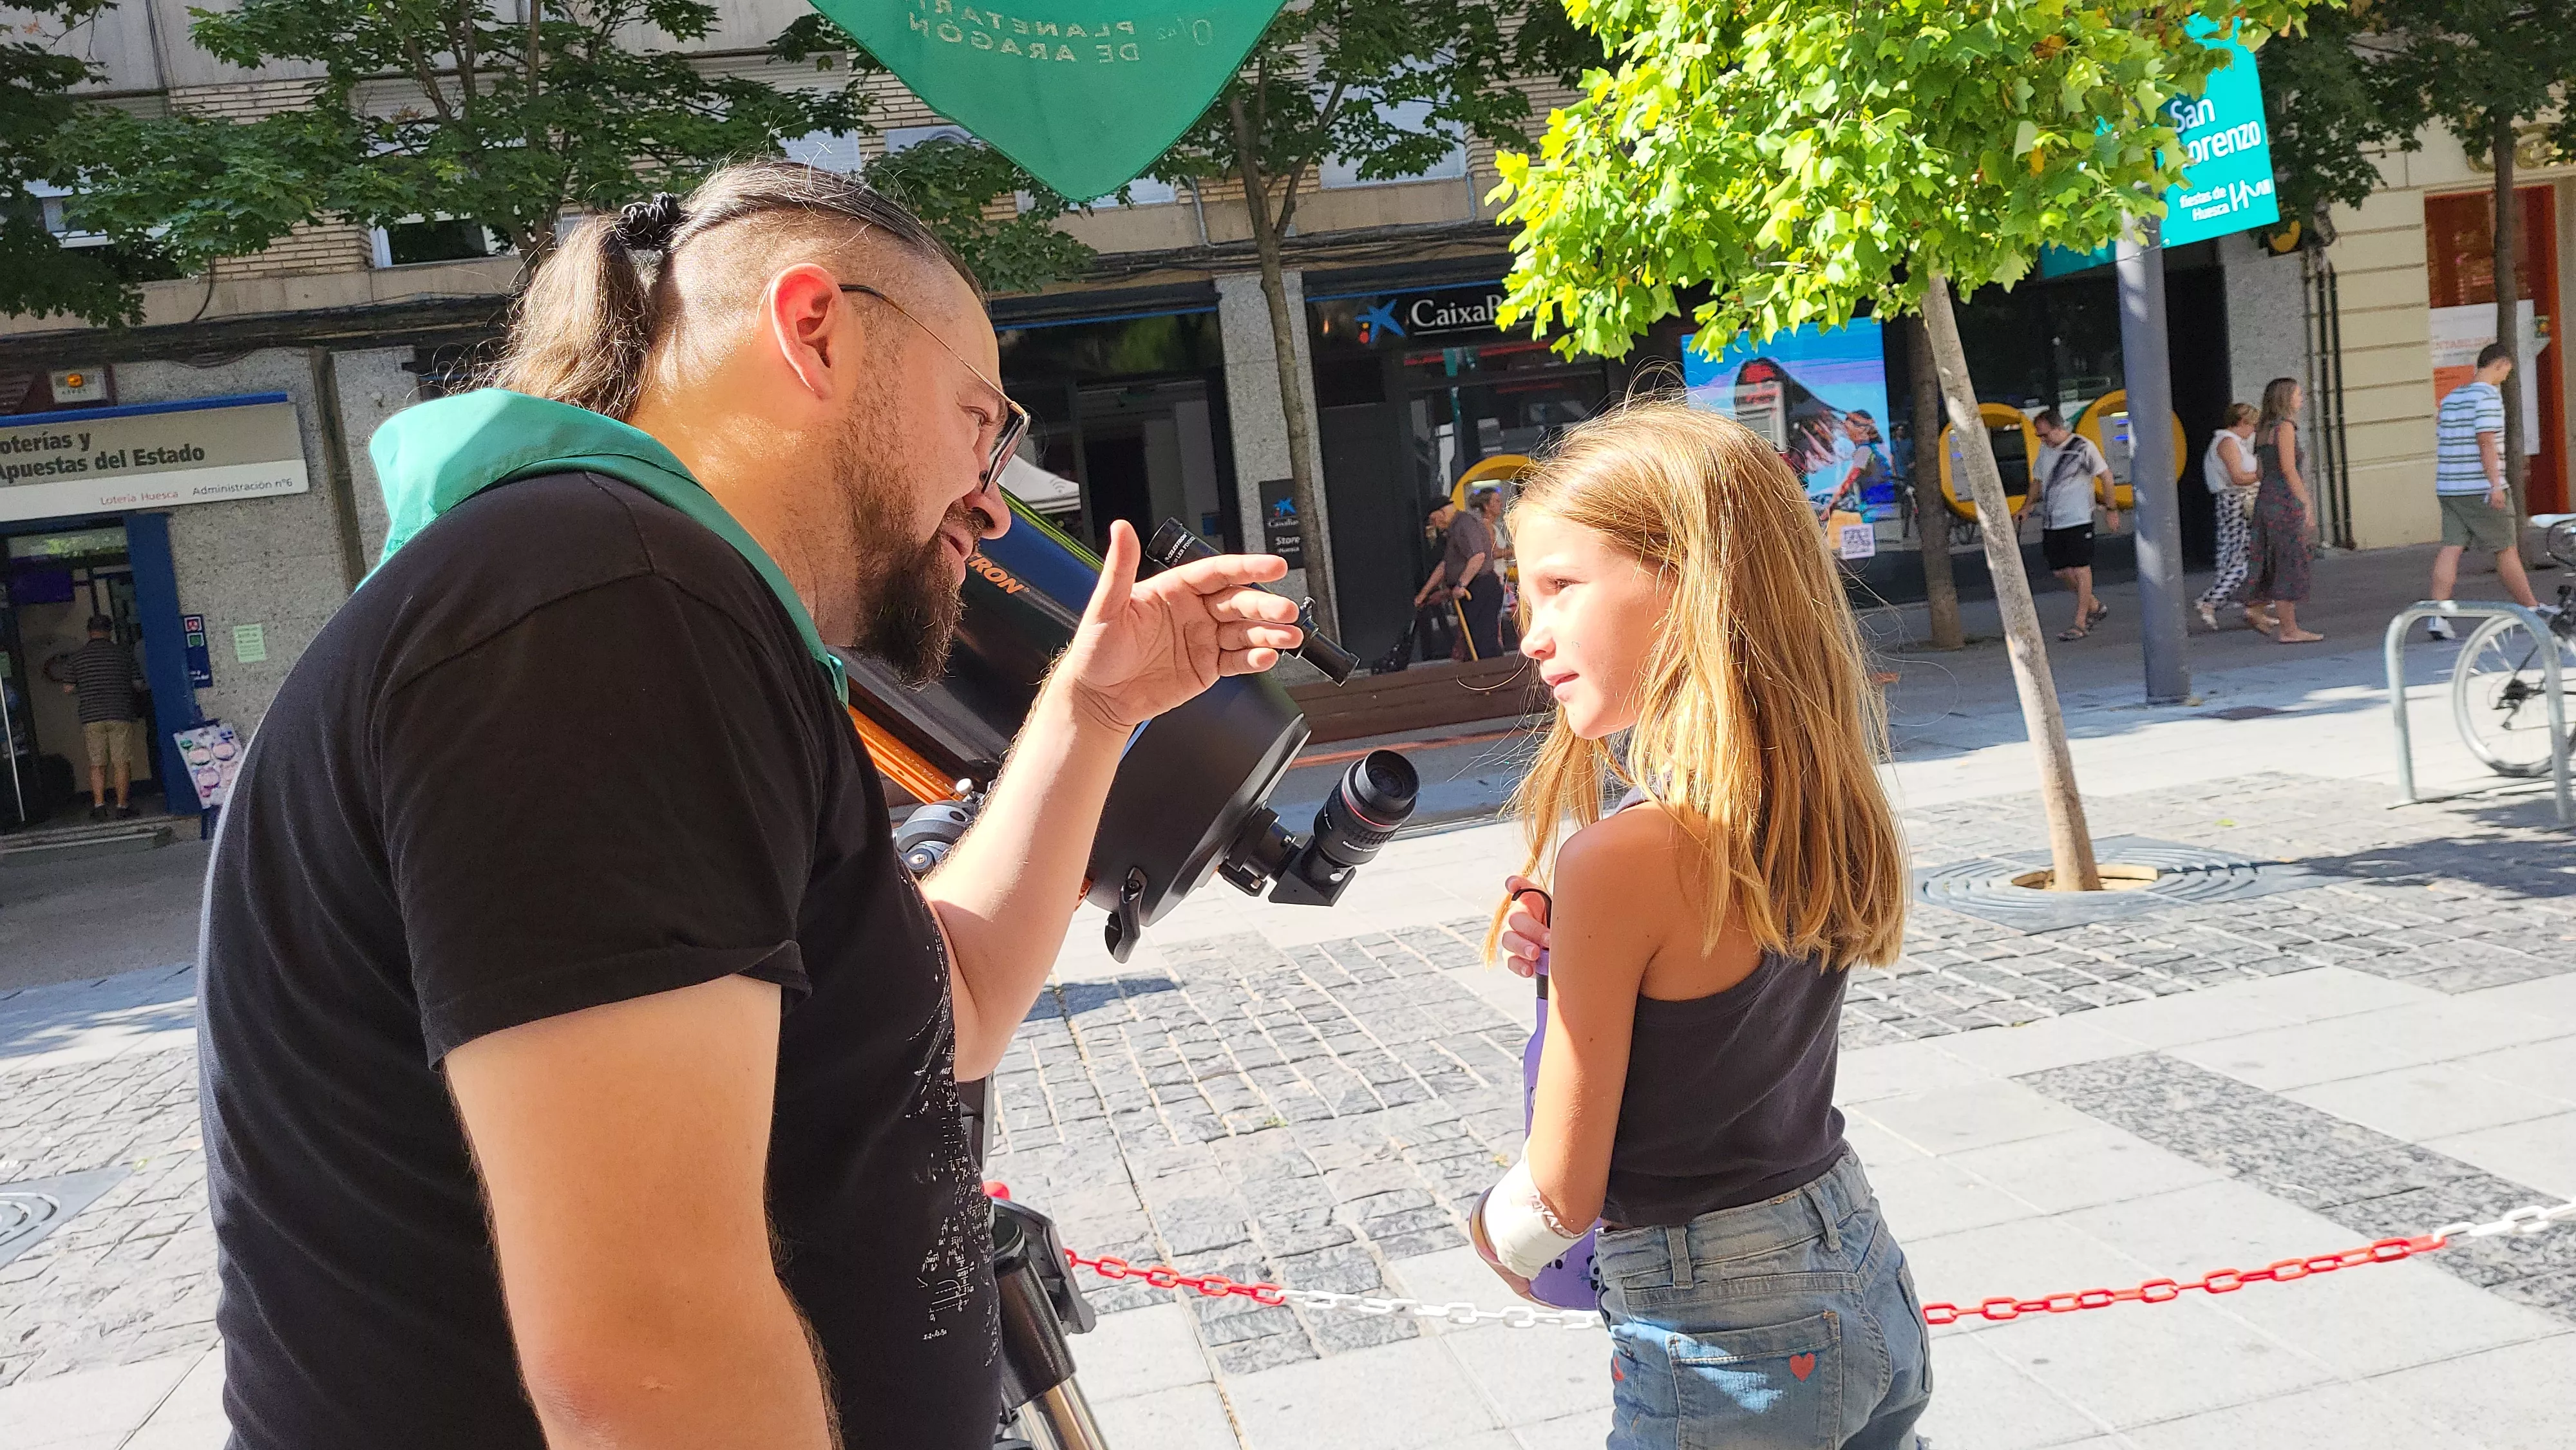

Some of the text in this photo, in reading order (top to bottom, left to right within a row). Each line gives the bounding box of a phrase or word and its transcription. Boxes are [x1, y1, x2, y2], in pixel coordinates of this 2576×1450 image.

[2170, 99, 2216, 133] San
[2183, 120, 2261, 166] orenzo
[2179, 191, 2212, 209] fiestas
[2212, 185, 2227, 200] de
[2192, 203, 2231, 221] Huesca
[0, 431, 91, 455] oterías y
[95, 449, 127, 470] del
[133, 444, 205, 466] Estado
